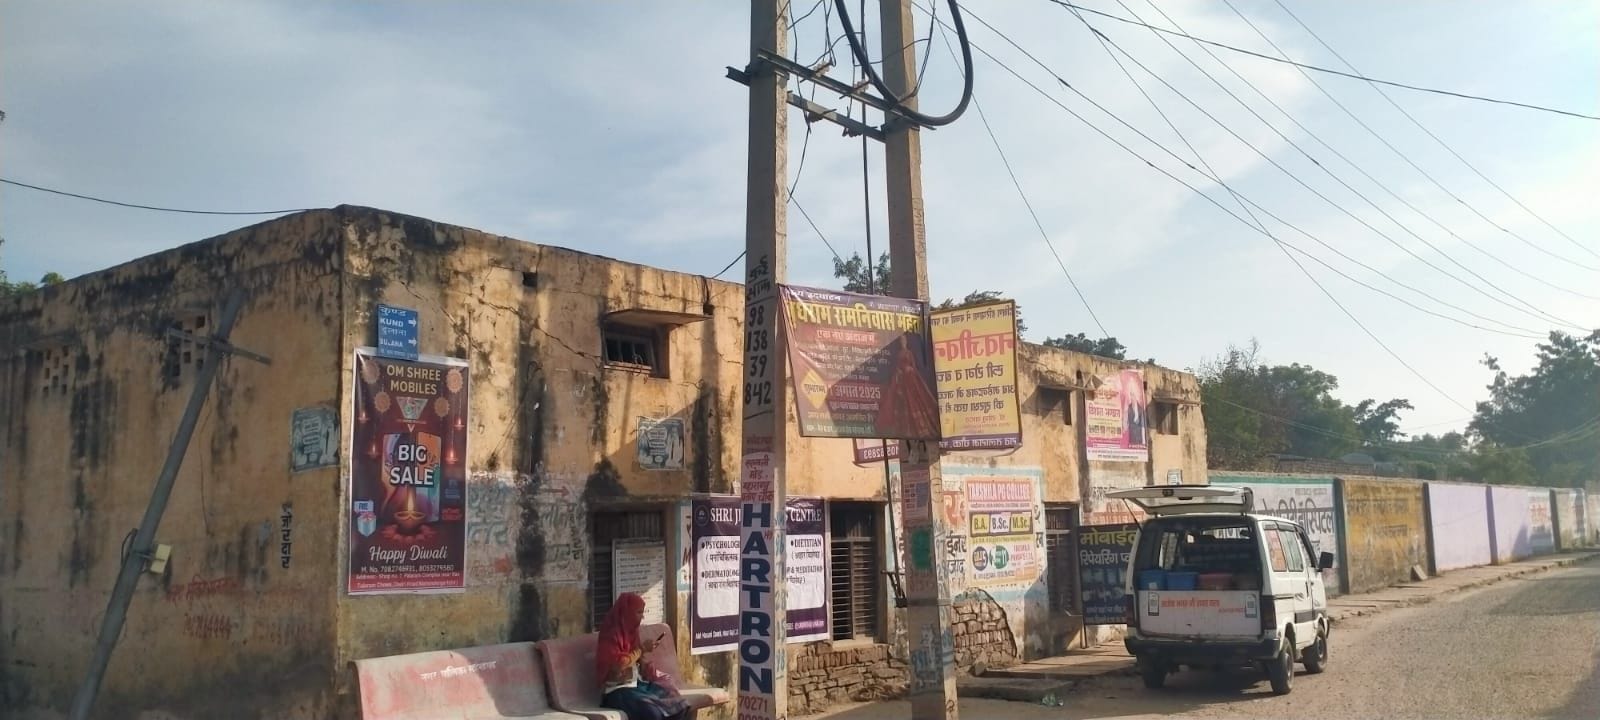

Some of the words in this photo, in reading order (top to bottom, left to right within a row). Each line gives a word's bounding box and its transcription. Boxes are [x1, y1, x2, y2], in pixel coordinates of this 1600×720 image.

[380, 318, 404, 327] KUND
[749, 305, 765, 327] 98
[833, 302, 895, 331] रामनिवास
[387, 365, 404, 378] OM
[406, 367, 441, 381] SHREE
[750, 355, 767, 377] 39
[390, 380, 437, 395] MOBILES
[744, 382, 772, 405] 842
[859, 386, 881, 400] 2025
[398, 444, 427, 462] BIG
[390, 466, 434, 486] SALE
[710, 507, 733, 522] SHRI
[790, 507, 822, 523] CENTRE
[974, 517, 988, 530] B.A.
[992, 516, 1009, 530] B.Sc.
[1012, 516, 1030, 529] M.Sc.
[369, 545, 406, 564] Happy
[410, 545, 448, 561] Diwali
[740, 503, 773, 694] HARTRON
